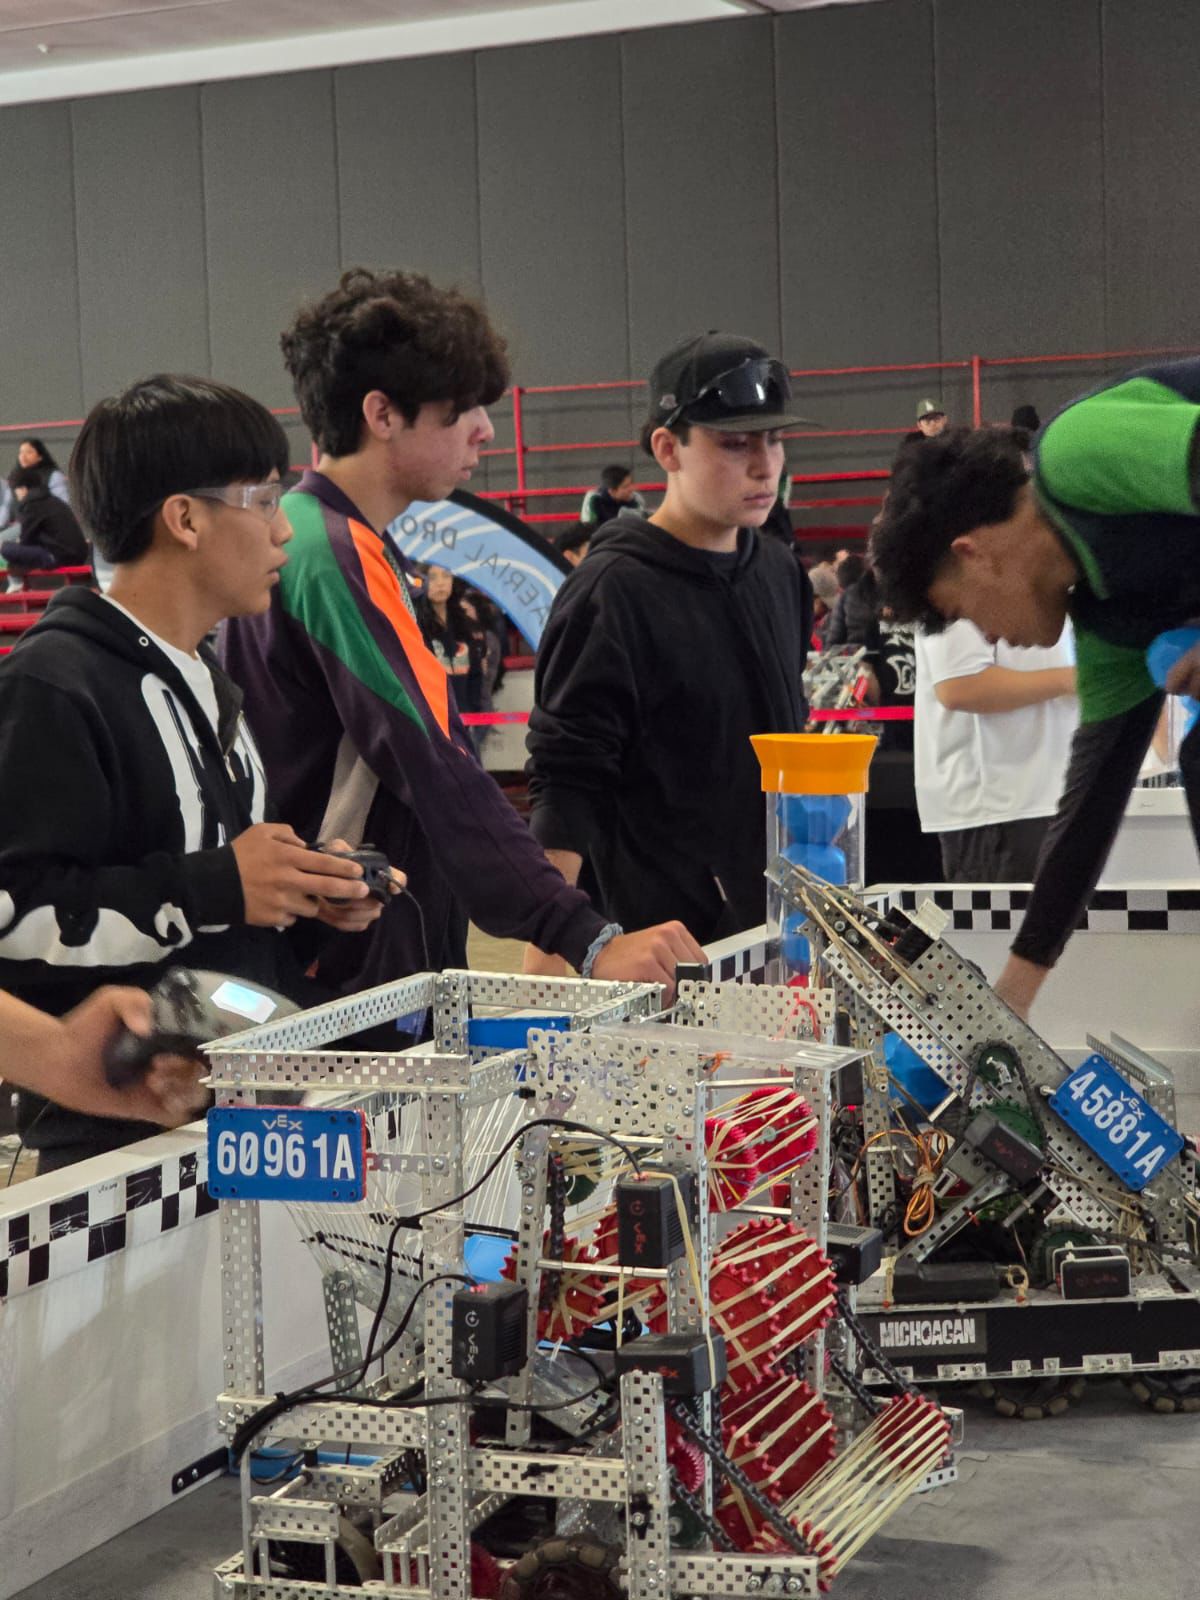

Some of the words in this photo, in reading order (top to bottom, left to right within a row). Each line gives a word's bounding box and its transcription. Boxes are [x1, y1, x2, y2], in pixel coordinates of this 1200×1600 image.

[1120, 1091, 1146, 1120] VEX
[262, 1114, 303, 1131] VEX
[1069, 1071, 1166, 1178] 45881A
[217, 1130, 356, 1180] 60961A
[880, 1318, 976, 1348] MICHOACAN
[467, 1333, 478, 1365] VEX
